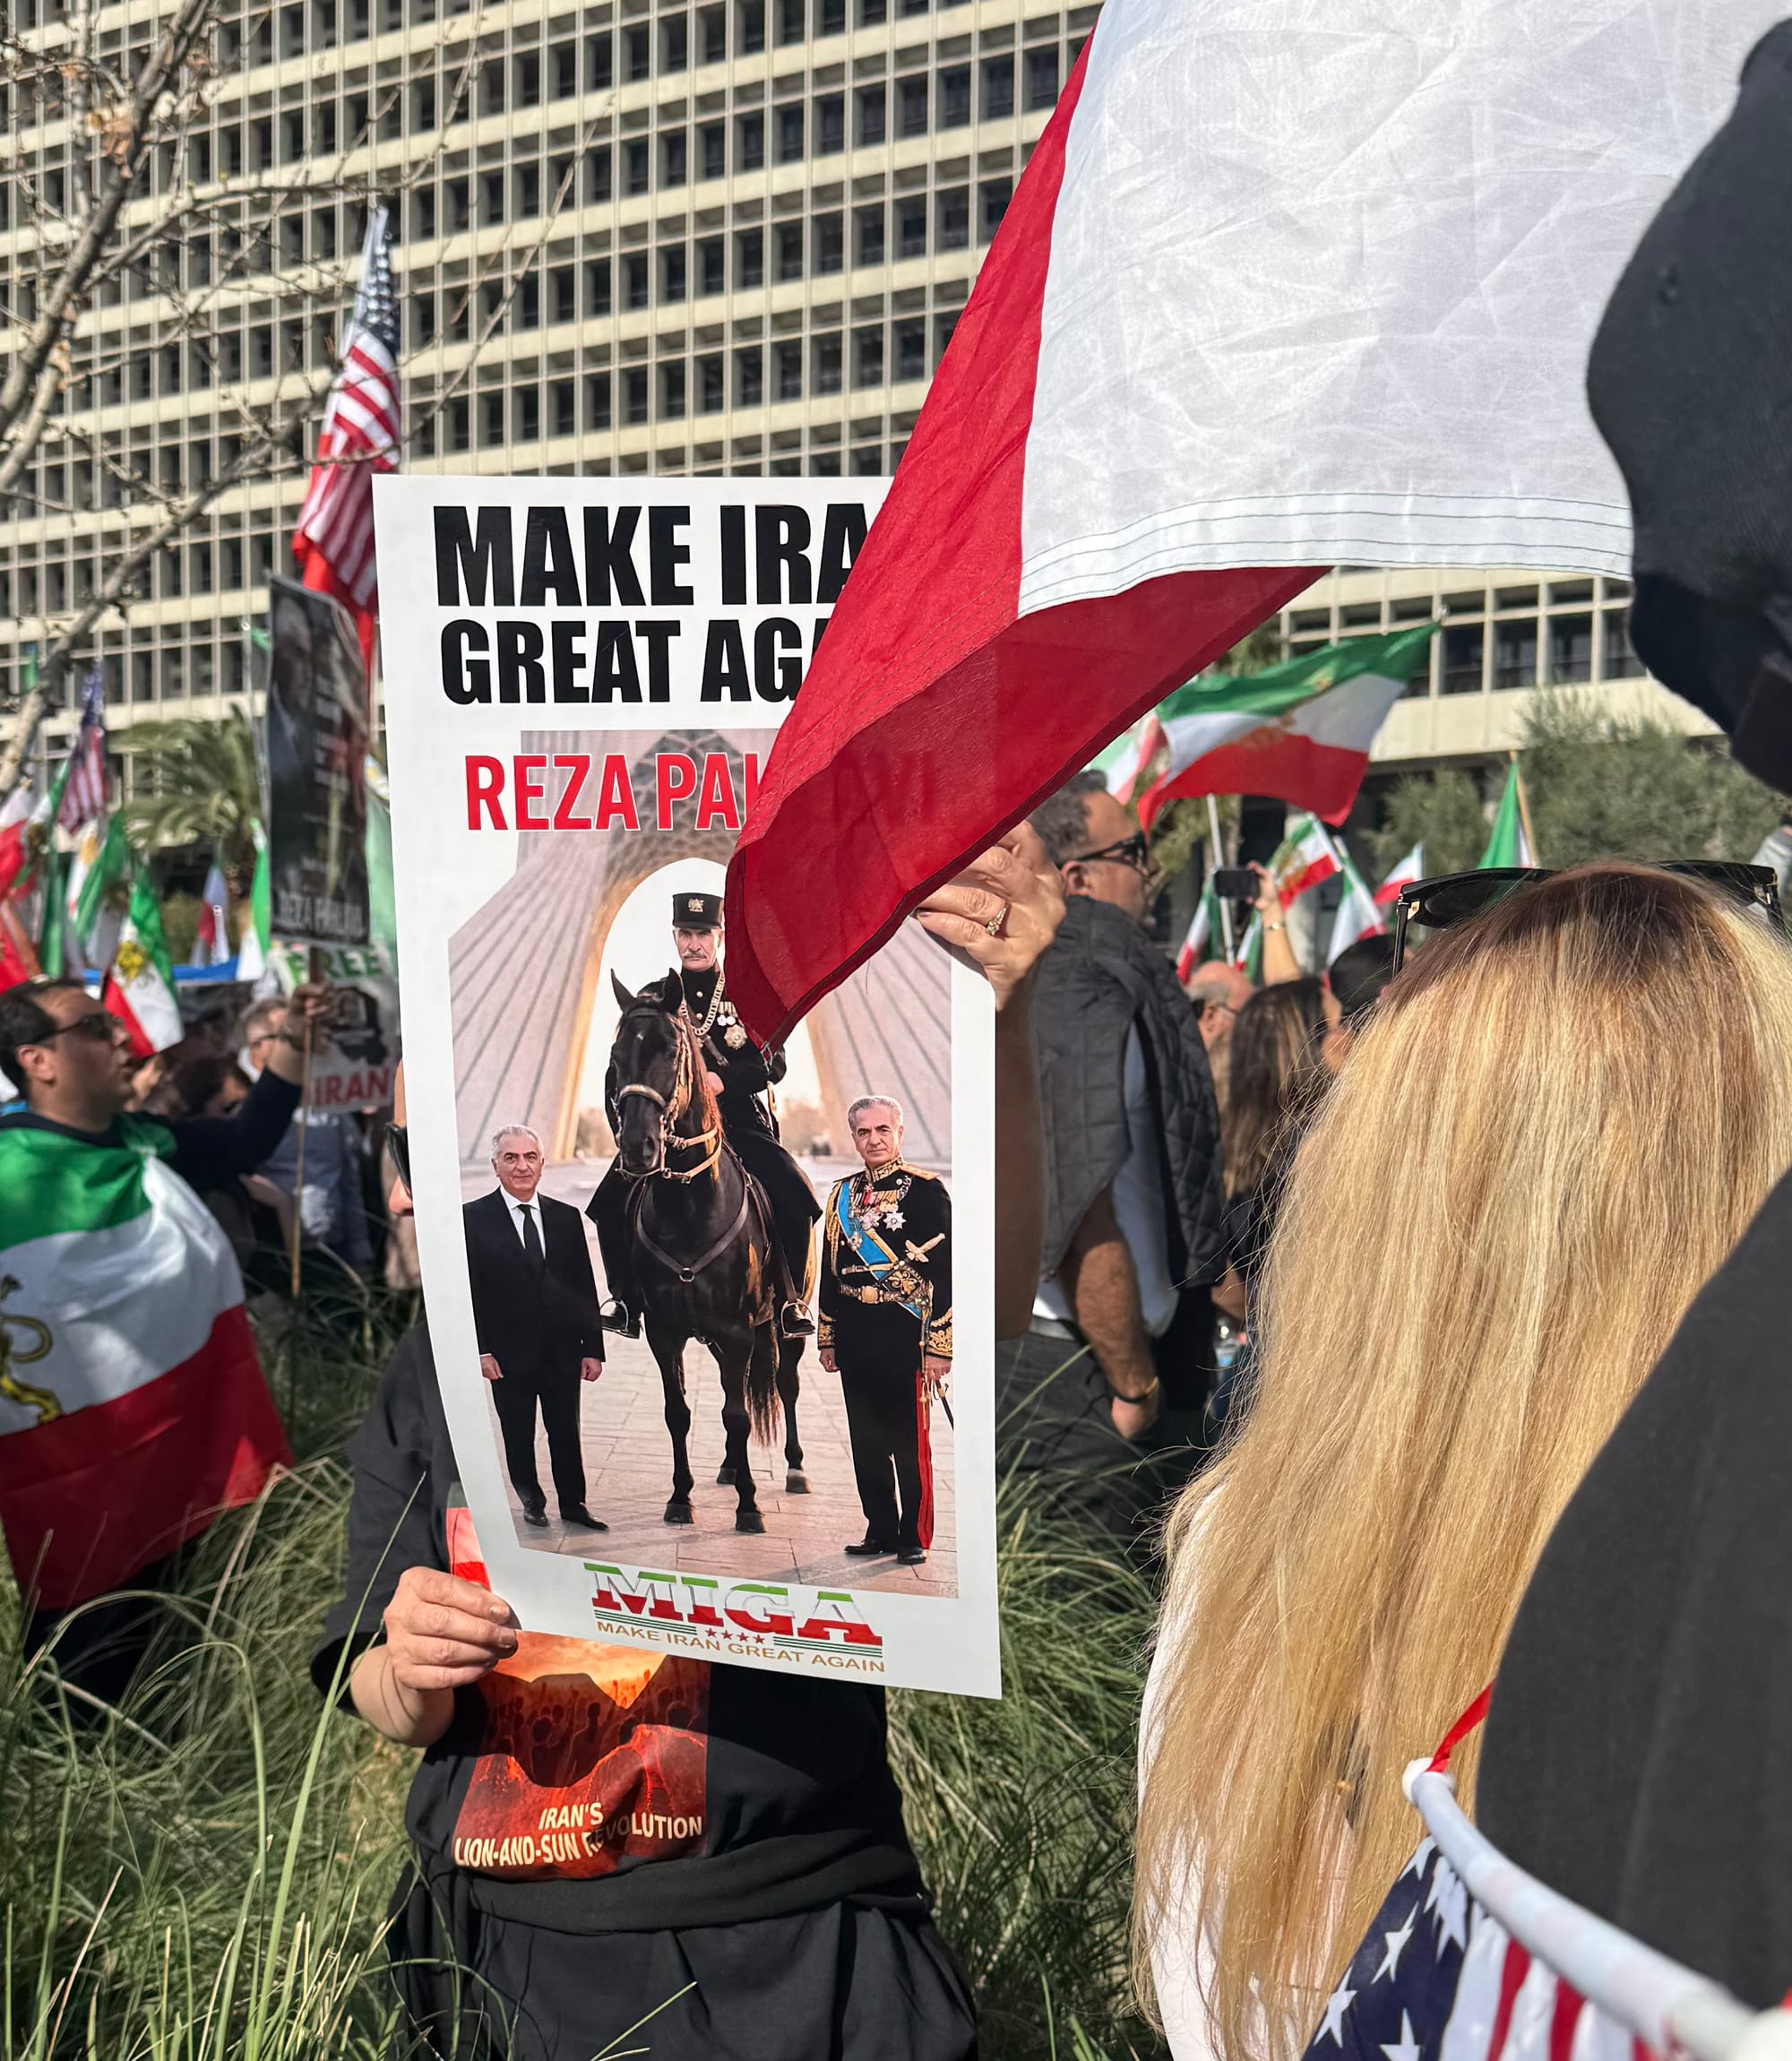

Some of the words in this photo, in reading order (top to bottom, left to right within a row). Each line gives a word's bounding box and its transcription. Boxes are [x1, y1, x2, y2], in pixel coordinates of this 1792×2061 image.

[433, 504, 694, 607] MAKE
[719, 503, 868, 606] IRA
[440, 617, 681, 705] GREAT
[464, 754, 640, 832] REZA
[314, 1067, 391, 1109] IRAN
[583, 1562, 883, 1646] MIGA
[597, 1621, 660, 1643] MAKE
[666, 1633, 721, 1651] IRAN
[728, 1643, 806, 1665] GREAT
[811, 1653, 886, 1674] AGAIN
[454, 1832, 581, 1867] LION-AND-SUN
[583, 1815, 702, 1858] REVOLUTION
[538, 1801, 604, 1831] IRAN'S
